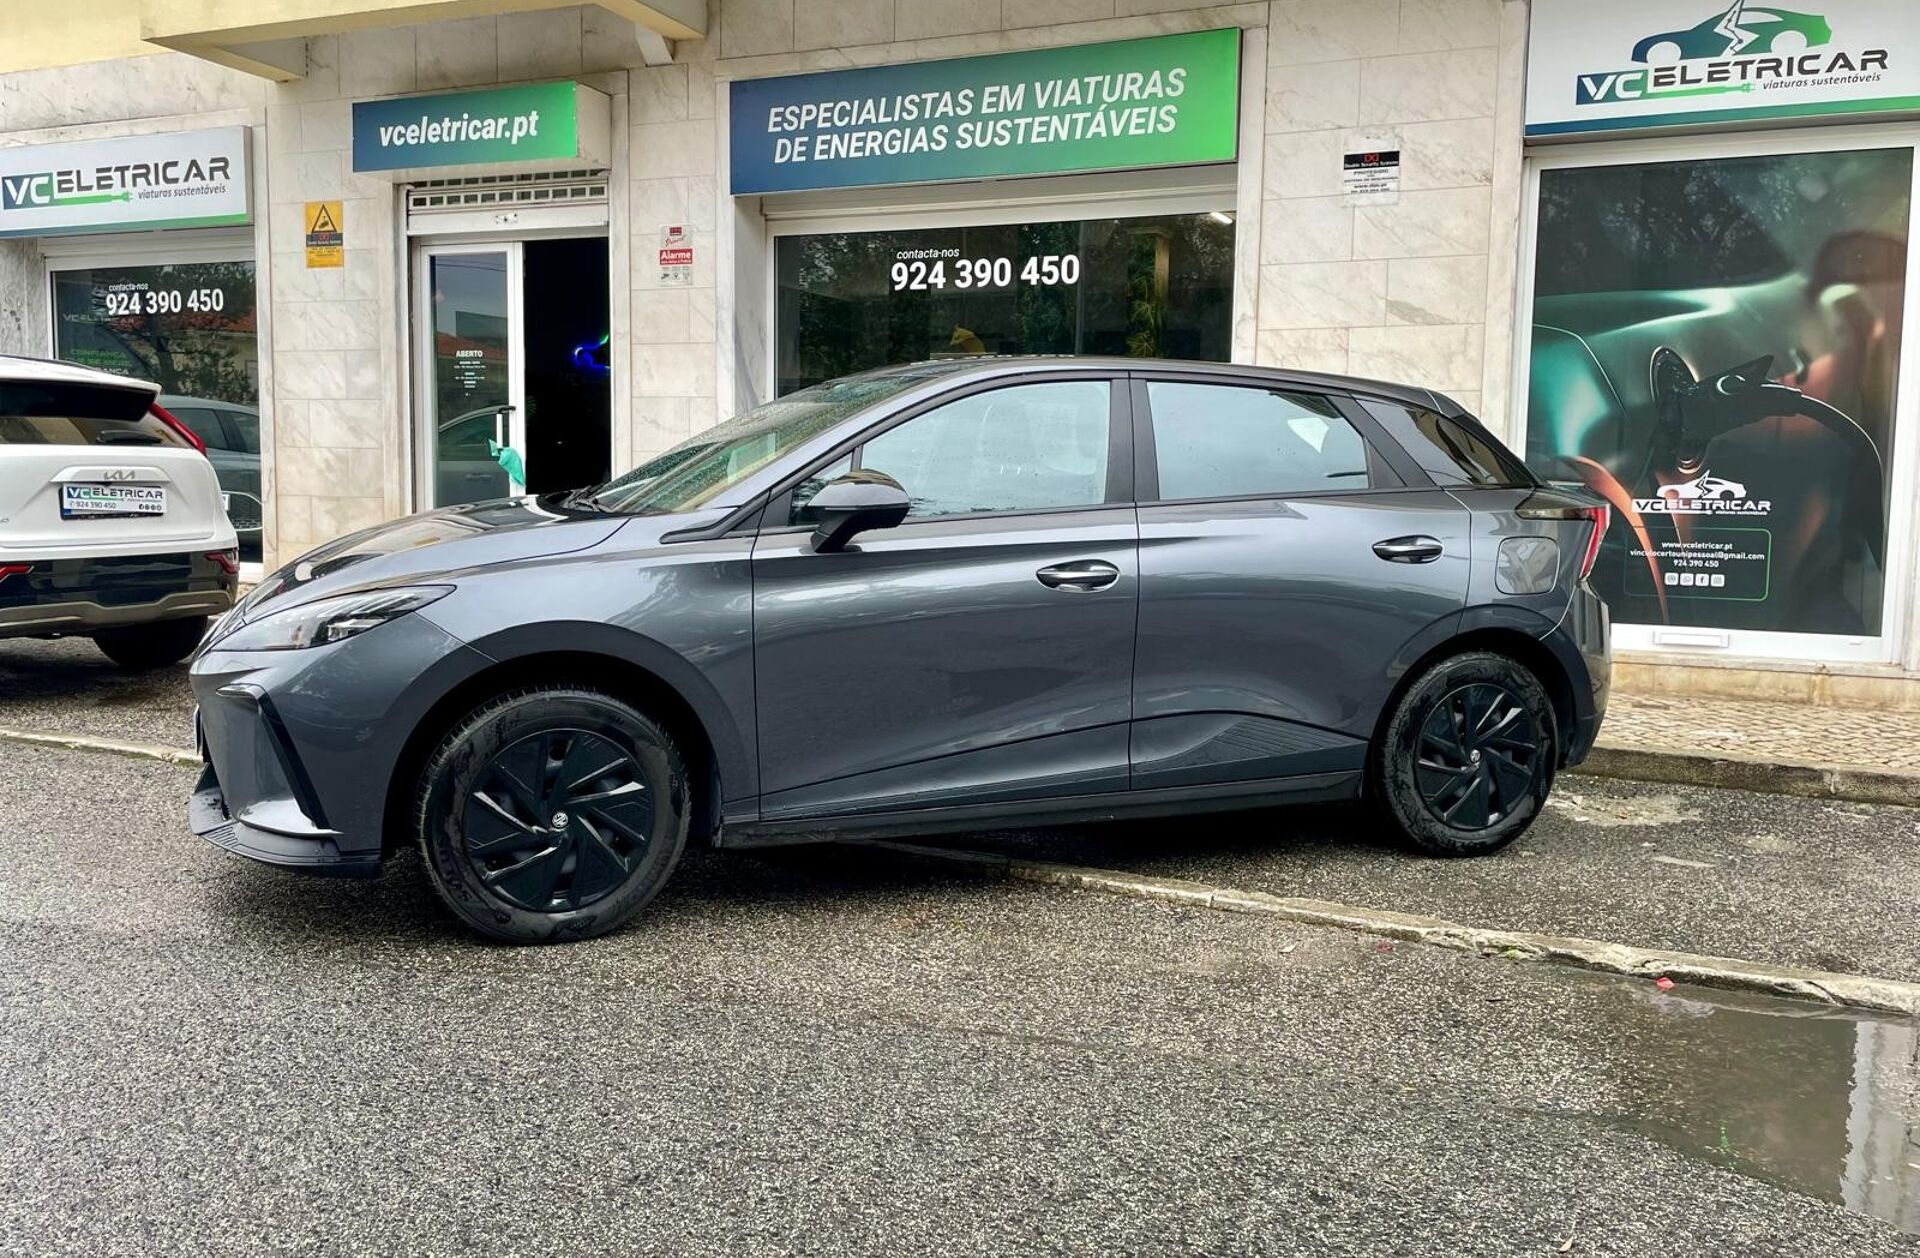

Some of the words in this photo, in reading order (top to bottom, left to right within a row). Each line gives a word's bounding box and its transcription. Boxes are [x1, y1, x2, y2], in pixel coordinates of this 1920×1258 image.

[1762, 77, 1808, 90] viaturas
[1811, 72, 1882, 87] sustentáveis
[767, 88, 975, 133] ESPECIALISTAS
[981, 83, 1027, 115] EM
[1034, 67, 1188, 110] VIATURAS
[379, 110, 540, 147] vceletricar.pt
[773, 136, 807, 164] DE
[814, 124, 949, 161] ENERGIAS
[955, 104, 1179, 149] SUSTENTÁVEIS
[138, 188, 172, 200] viaturas
[174, 182, 227, 197] sustentáveis
[660, 251, 692, 260] Alarme
[896, 248, 960, 260] contacta-nos
[890, 260, 947, 291] 924
[954, 257, 1012, 289] 390
[1020, 254, 1081, 286] 450
[108, 282, 149, 292] contacta-nos
[106, 292, 141, 315] 924
[145, 290, 182, 314] 390
[186, 288, 224, 312] 450
[456, 350, 484, 358] ABERTO
[103, 470, 136, 480] KIA
[1673, 559, 1687, 567] 924
[1689, 559, 1704, 567] 390
[1704, 560, 1720, 568] 450
